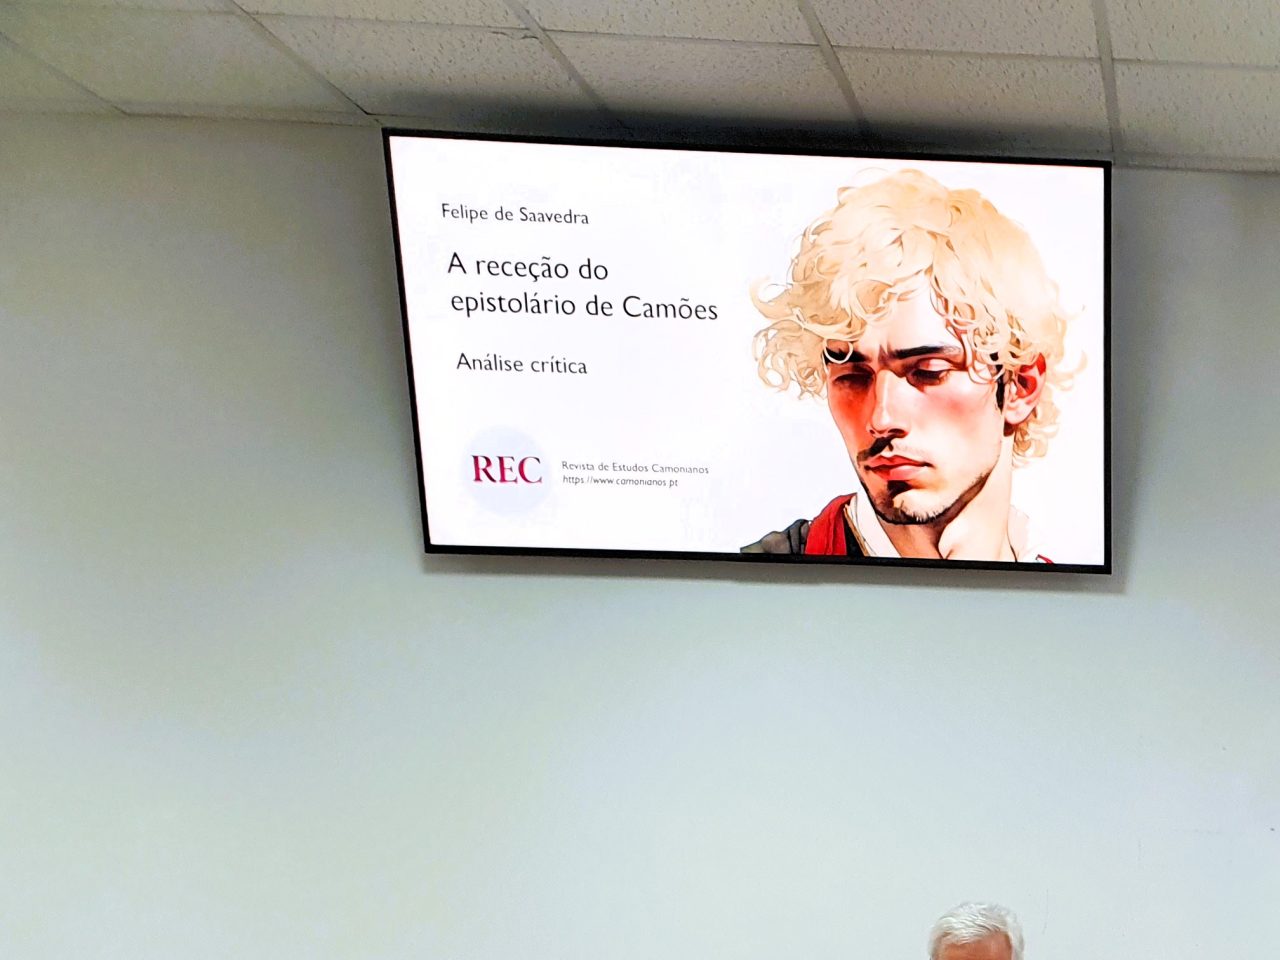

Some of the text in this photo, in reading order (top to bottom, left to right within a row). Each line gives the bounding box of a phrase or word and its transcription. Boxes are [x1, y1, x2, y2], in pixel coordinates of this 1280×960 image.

[441, 202, 589, 225] Felipe de Saavedra
[447, 251, 609, 283] A receção do
[450, 291, 718, 321] epistolário de Camões
[456, 352, 588, 375] Análise crítica
[471, 454, 543, 485] REC
[561, 460, 709, 474] Revista de Estudos Camonianos
[562, 475, 678, 488] https//wwwcamonianospt
